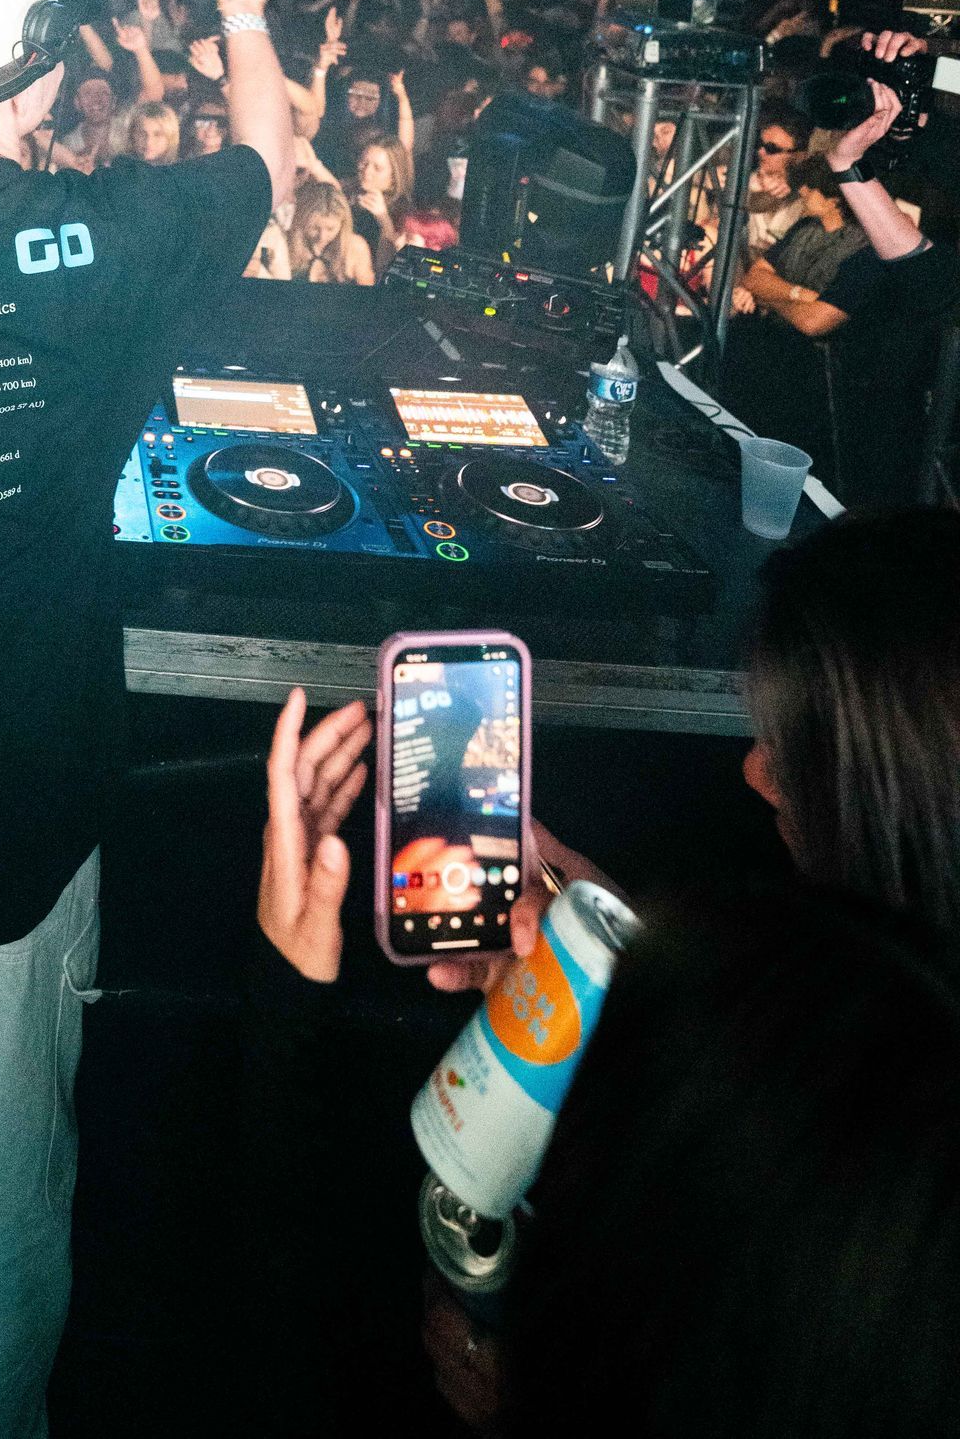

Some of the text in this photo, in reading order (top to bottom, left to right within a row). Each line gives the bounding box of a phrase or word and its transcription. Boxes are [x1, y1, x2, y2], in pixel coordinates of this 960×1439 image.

[15, 223, 94, 274] GO
[17, 353, 33, 366] km)
[1, 380, 20, 391] 700
[20, 377, 37, 389] km)
[16, 402, 28, 410] 57
[28, 399, 46, 409] AU)
[15, 449, 21, 459] d
[17, 484, 22, 494] d
[257, 538, 310, 547] Pioneer
[536, 555, 589, 564] Pioneer
